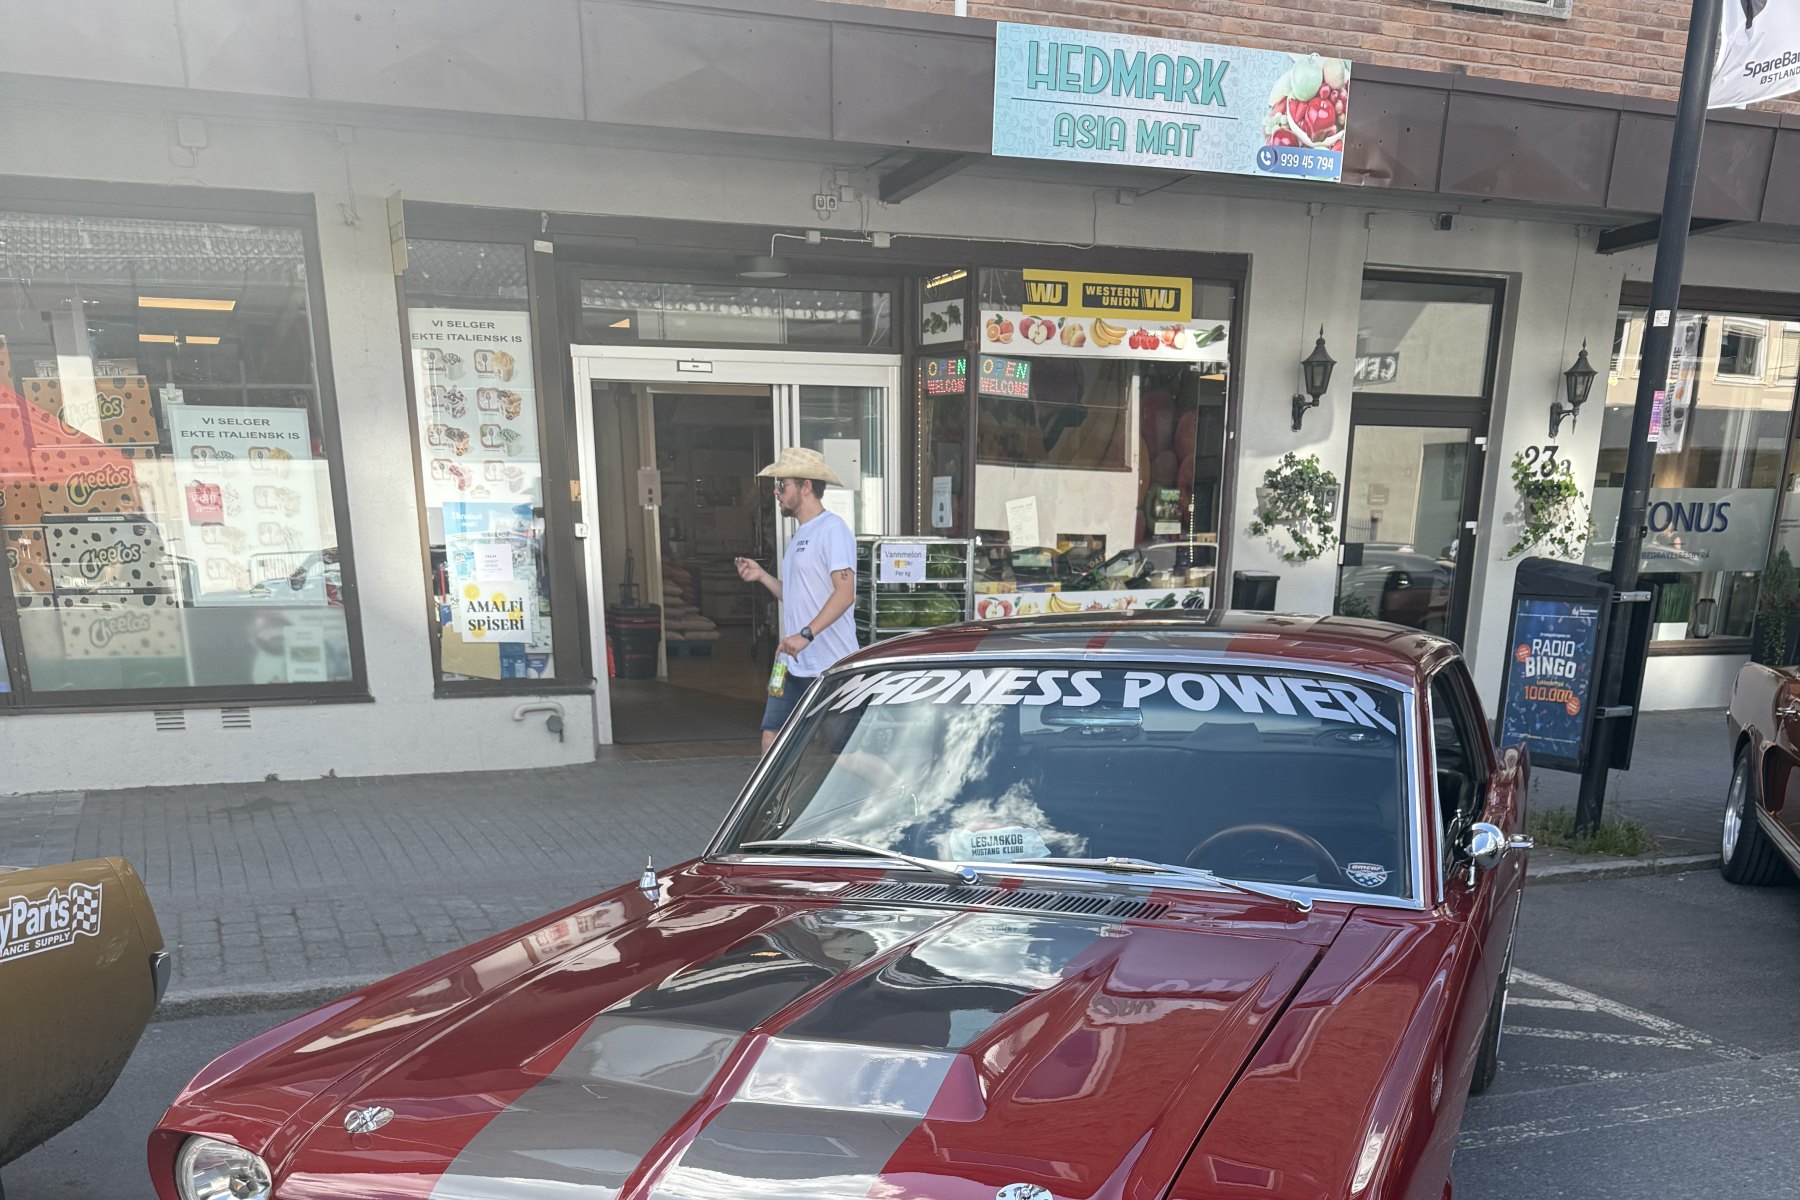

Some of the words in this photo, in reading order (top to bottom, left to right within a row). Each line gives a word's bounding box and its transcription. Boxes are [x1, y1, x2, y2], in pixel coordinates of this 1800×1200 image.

[1027, 40, 1230, 107] HEDMARK
[1053, 112, 1126, 152] ASIA
[1136, 119, 1201, 158] MAT
[1281, 153, 1299, 168] 939
[1302, 155, 1314, 169] 45
[1317, 156, 1335, 171] 794
[1029, 282, 1064, 304] WU
[1085, 284, 1140, 298] WESTERN
[1145, 287, 1177, 310] WU
[1102, 295, 1139, 308] UNION
[446, 320, 496, 329] SELGER
[411, 332, 444, 341] EKTE
[447, 333, 508, 343] ITALIENSK
[511, 335, 523, 343] IS
[928, 358, 967, 377] OPEN
[982, 359, 1028, 379] OPEN
[927, 378, 966, 394] WELCOM
[980, 377, 1029, 397] WELCOME
[60, 394, 122, 435] Cheetos
[202, 417, 215, 425] VI
[218, 418, 270, 426] SELGER
[181, 430, 215, 438] EKTE
[219, 431, 284, 440] ITALIENSK
[288, 432, 300, 440] IS
[69, 464, 131, 505] Cheetos
[1648, 501, 1730, 532] ONUS
[80, 541, 141, 579] Cheetos
[885, 551, 922, 559] Vannmelon
[90, 611, 149, 647] Cheetos
[1532, 638, 1576, 658] RADIO
[1525, 656, 1577, 679] BINGO
[806, 669, 1102, 718] MADNESS
[1123, 671, 1397, 736] POWER
[1524, 685, 1573, 703] 100.000
[971, 834, 1023, 848] LESJASKOG
[972, 847, 1000, 856] MUSTANG
[1003, 846, 1024, 854] KLUBB
[0, 942, 30, 957] ANCE
[35, 932, 70, 949] SUPPLY
